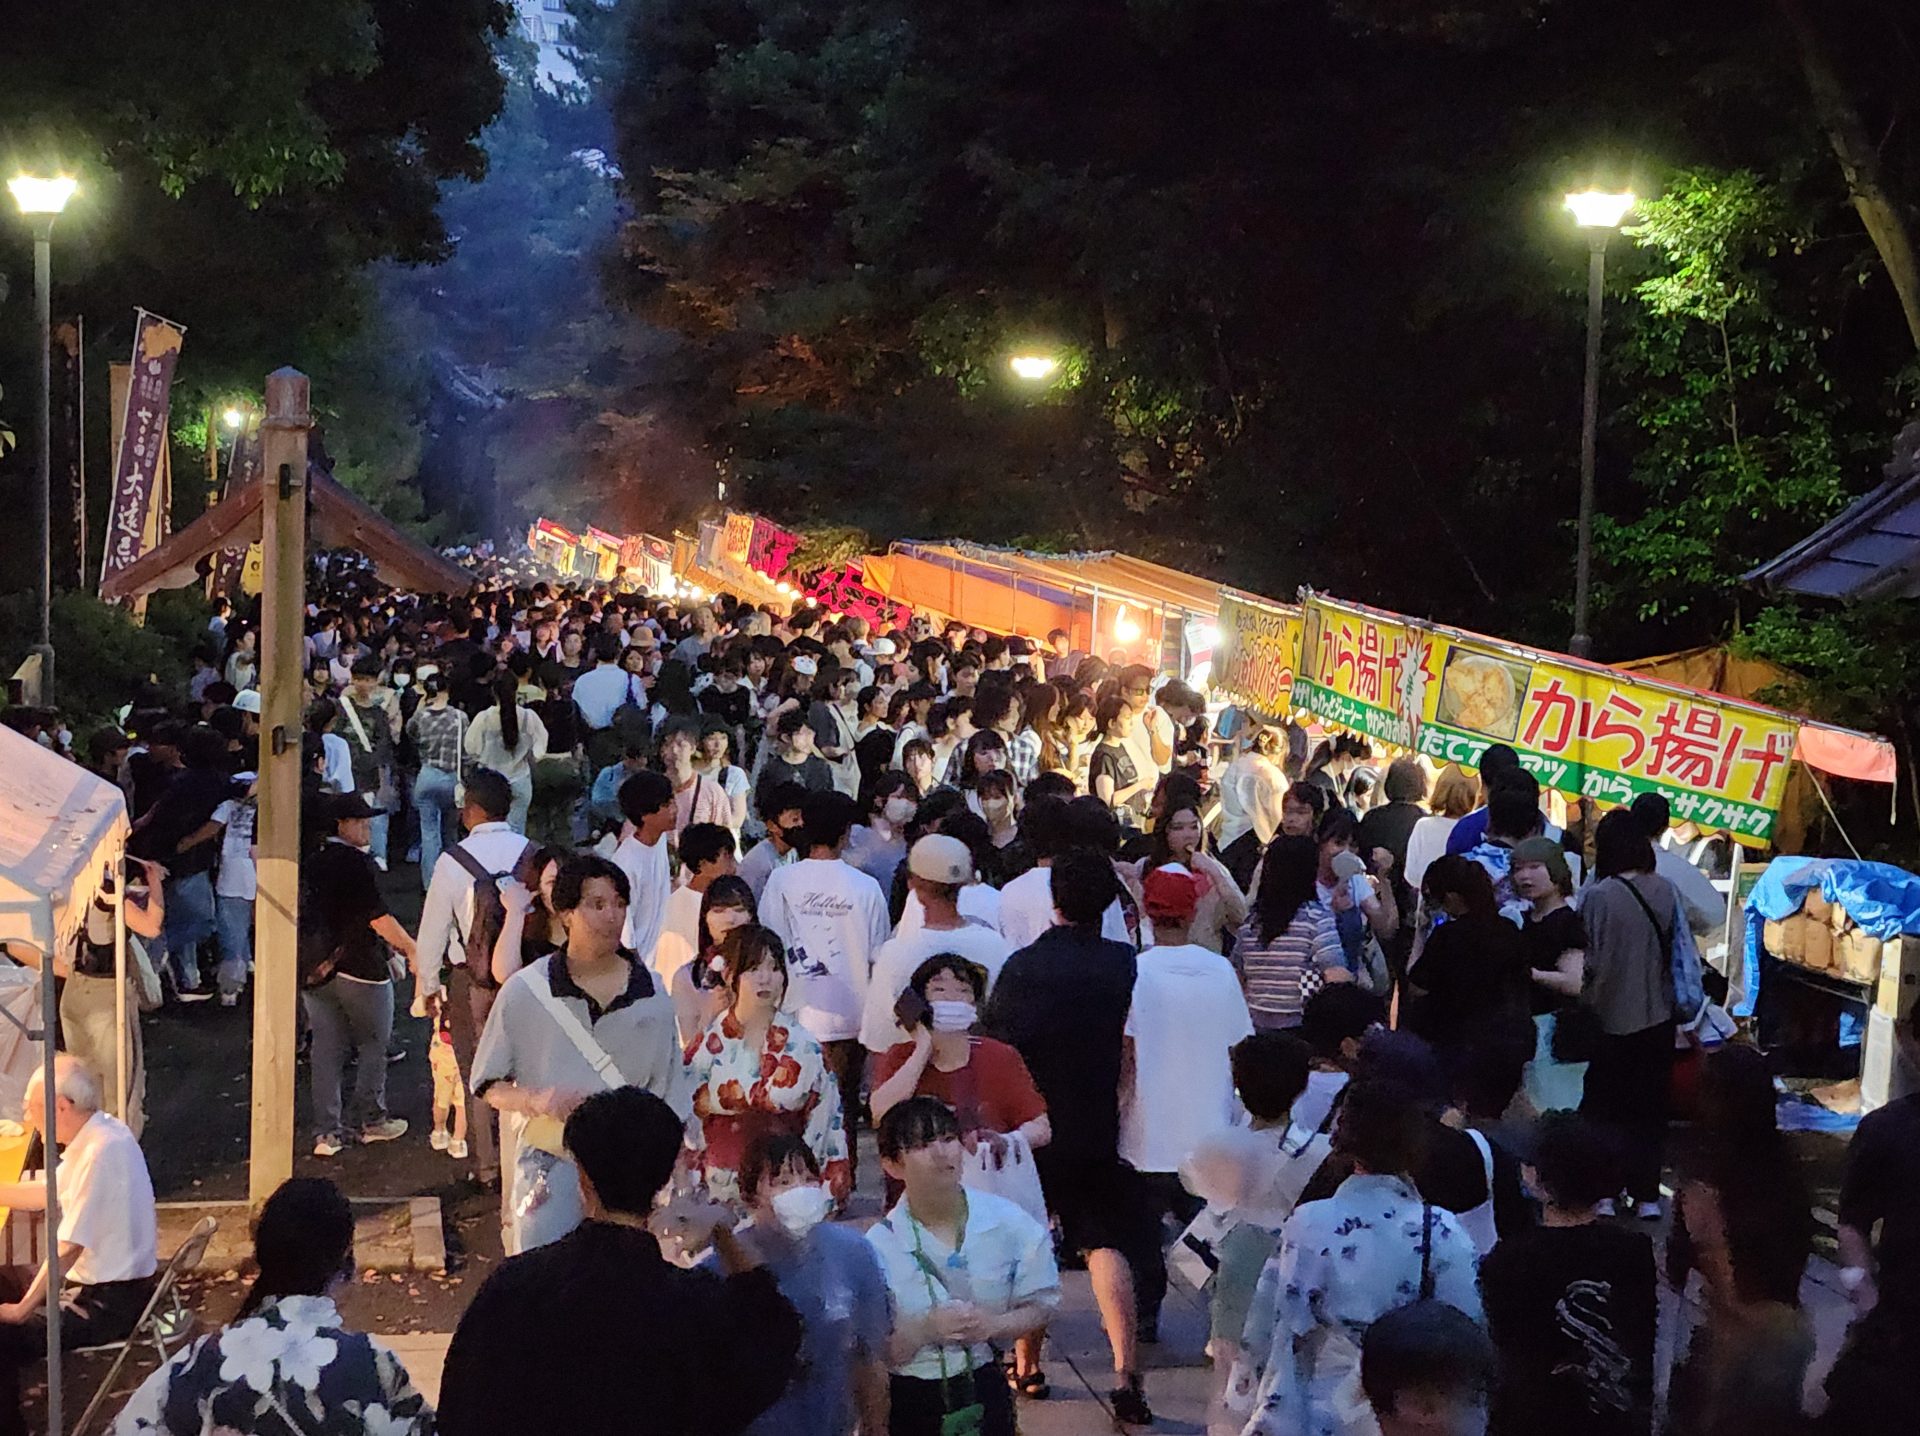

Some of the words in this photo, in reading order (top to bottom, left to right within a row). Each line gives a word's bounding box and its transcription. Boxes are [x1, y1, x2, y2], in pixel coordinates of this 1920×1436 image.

[1319, 618, 1407, 710] から揚げ
[1521, 679, 1792, 802] から揚げ
[1581, 770, 1772, 836] からサクサク
